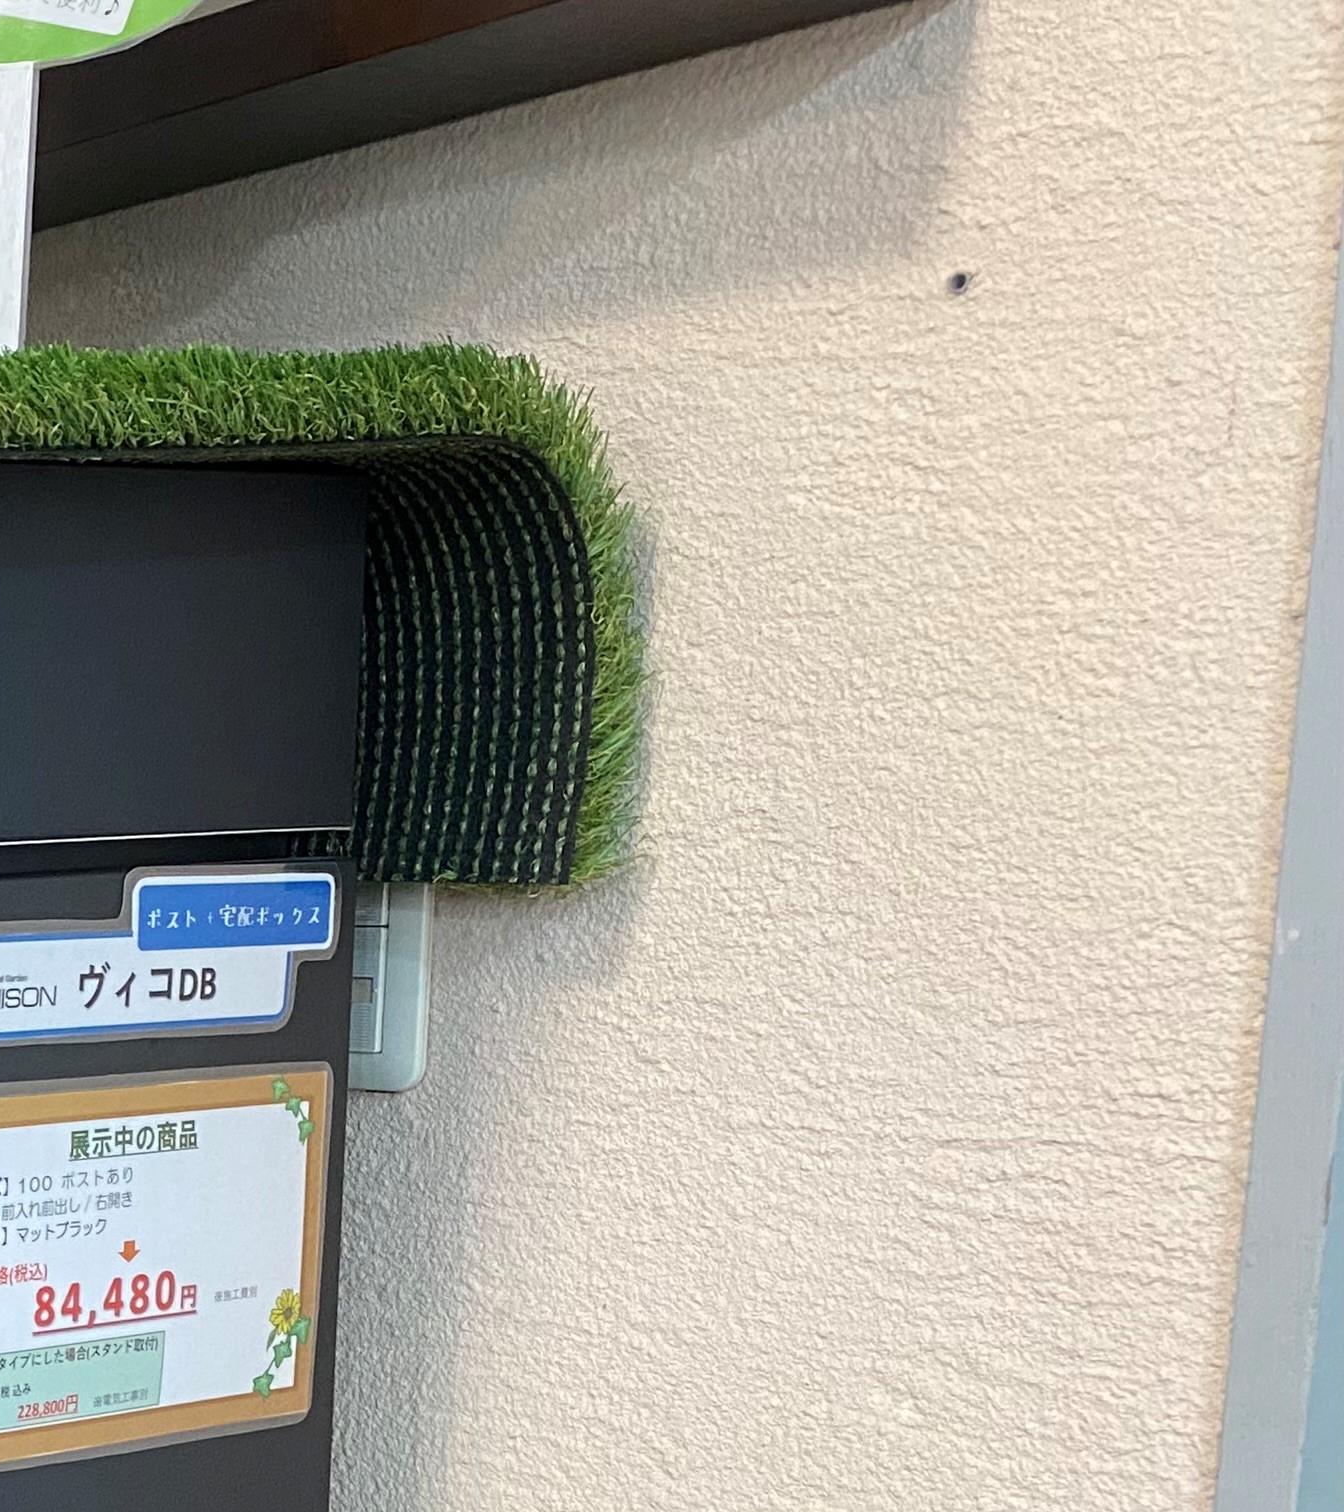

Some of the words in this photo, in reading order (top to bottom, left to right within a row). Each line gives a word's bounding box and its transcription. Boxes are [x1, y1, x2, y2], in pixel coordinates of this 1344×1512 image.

[77, 961, 218, 1010] ヴィコDB
[69, 1120, 198, 1160] 展示中の商品
[33, 1270, 198, 1329] 84,480円
[17, 1395, 80, 1421] 228,800円
